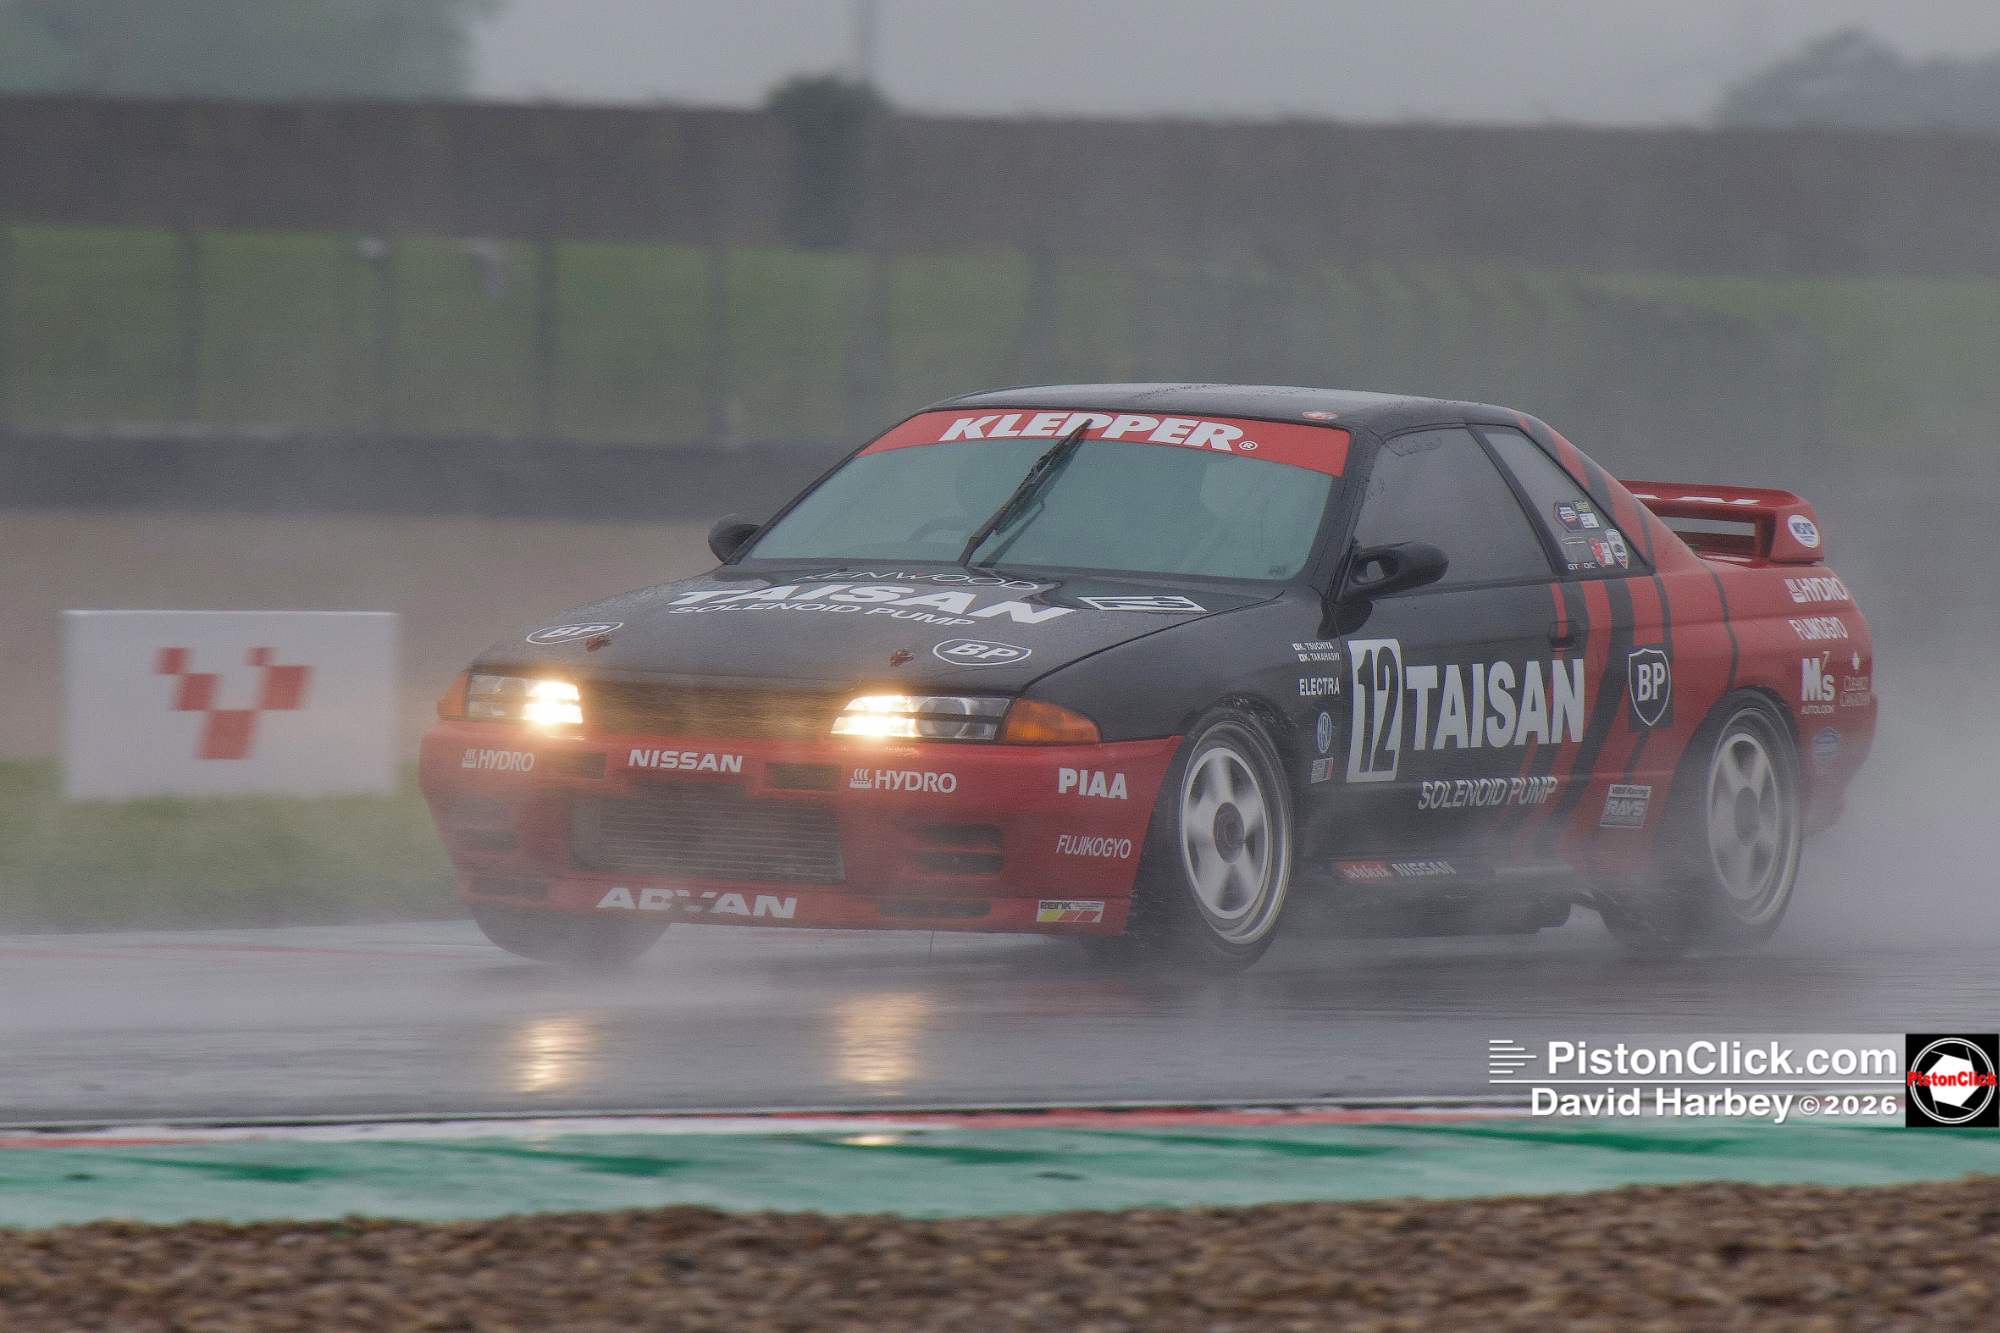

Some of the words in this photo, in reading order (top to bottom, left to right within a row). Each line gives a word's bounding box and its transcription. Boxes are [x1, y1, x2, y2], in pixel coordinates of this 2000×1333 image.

[939, 412, 1244, 452] KLEPPER
[668, 584, 1076, 624] TAISAN
[668, 602, 861, 614] SOLENOID
[864, 607, 975, 626] PUMP
[537, 625, 612, 638] BP
[948, 643, 1019, 659] BP
[1299, 677, 1340, 696] ELECTRA
[1637, 661, 1666, 701] BP
[1357, 645, 1399, 773] 12
[1406, 658, 1585, 750] TAISAN
[477, 750, 535, 772] HYDRO
[628, 748, 743, 773] NISSAN
[874, 769, 957, 793] HYDRO
[1058, 767, 1128, 800] PIAA
[1418, 778, 1508, 810] SOLENOID
[1507, 776, 1559, 805] PUMP
[1604, 799, 1646, 816] RAYS
[1055, 834, 1132, 859] FUJIKOGYO
[1391, 861, 1457, 877] NISSAN
